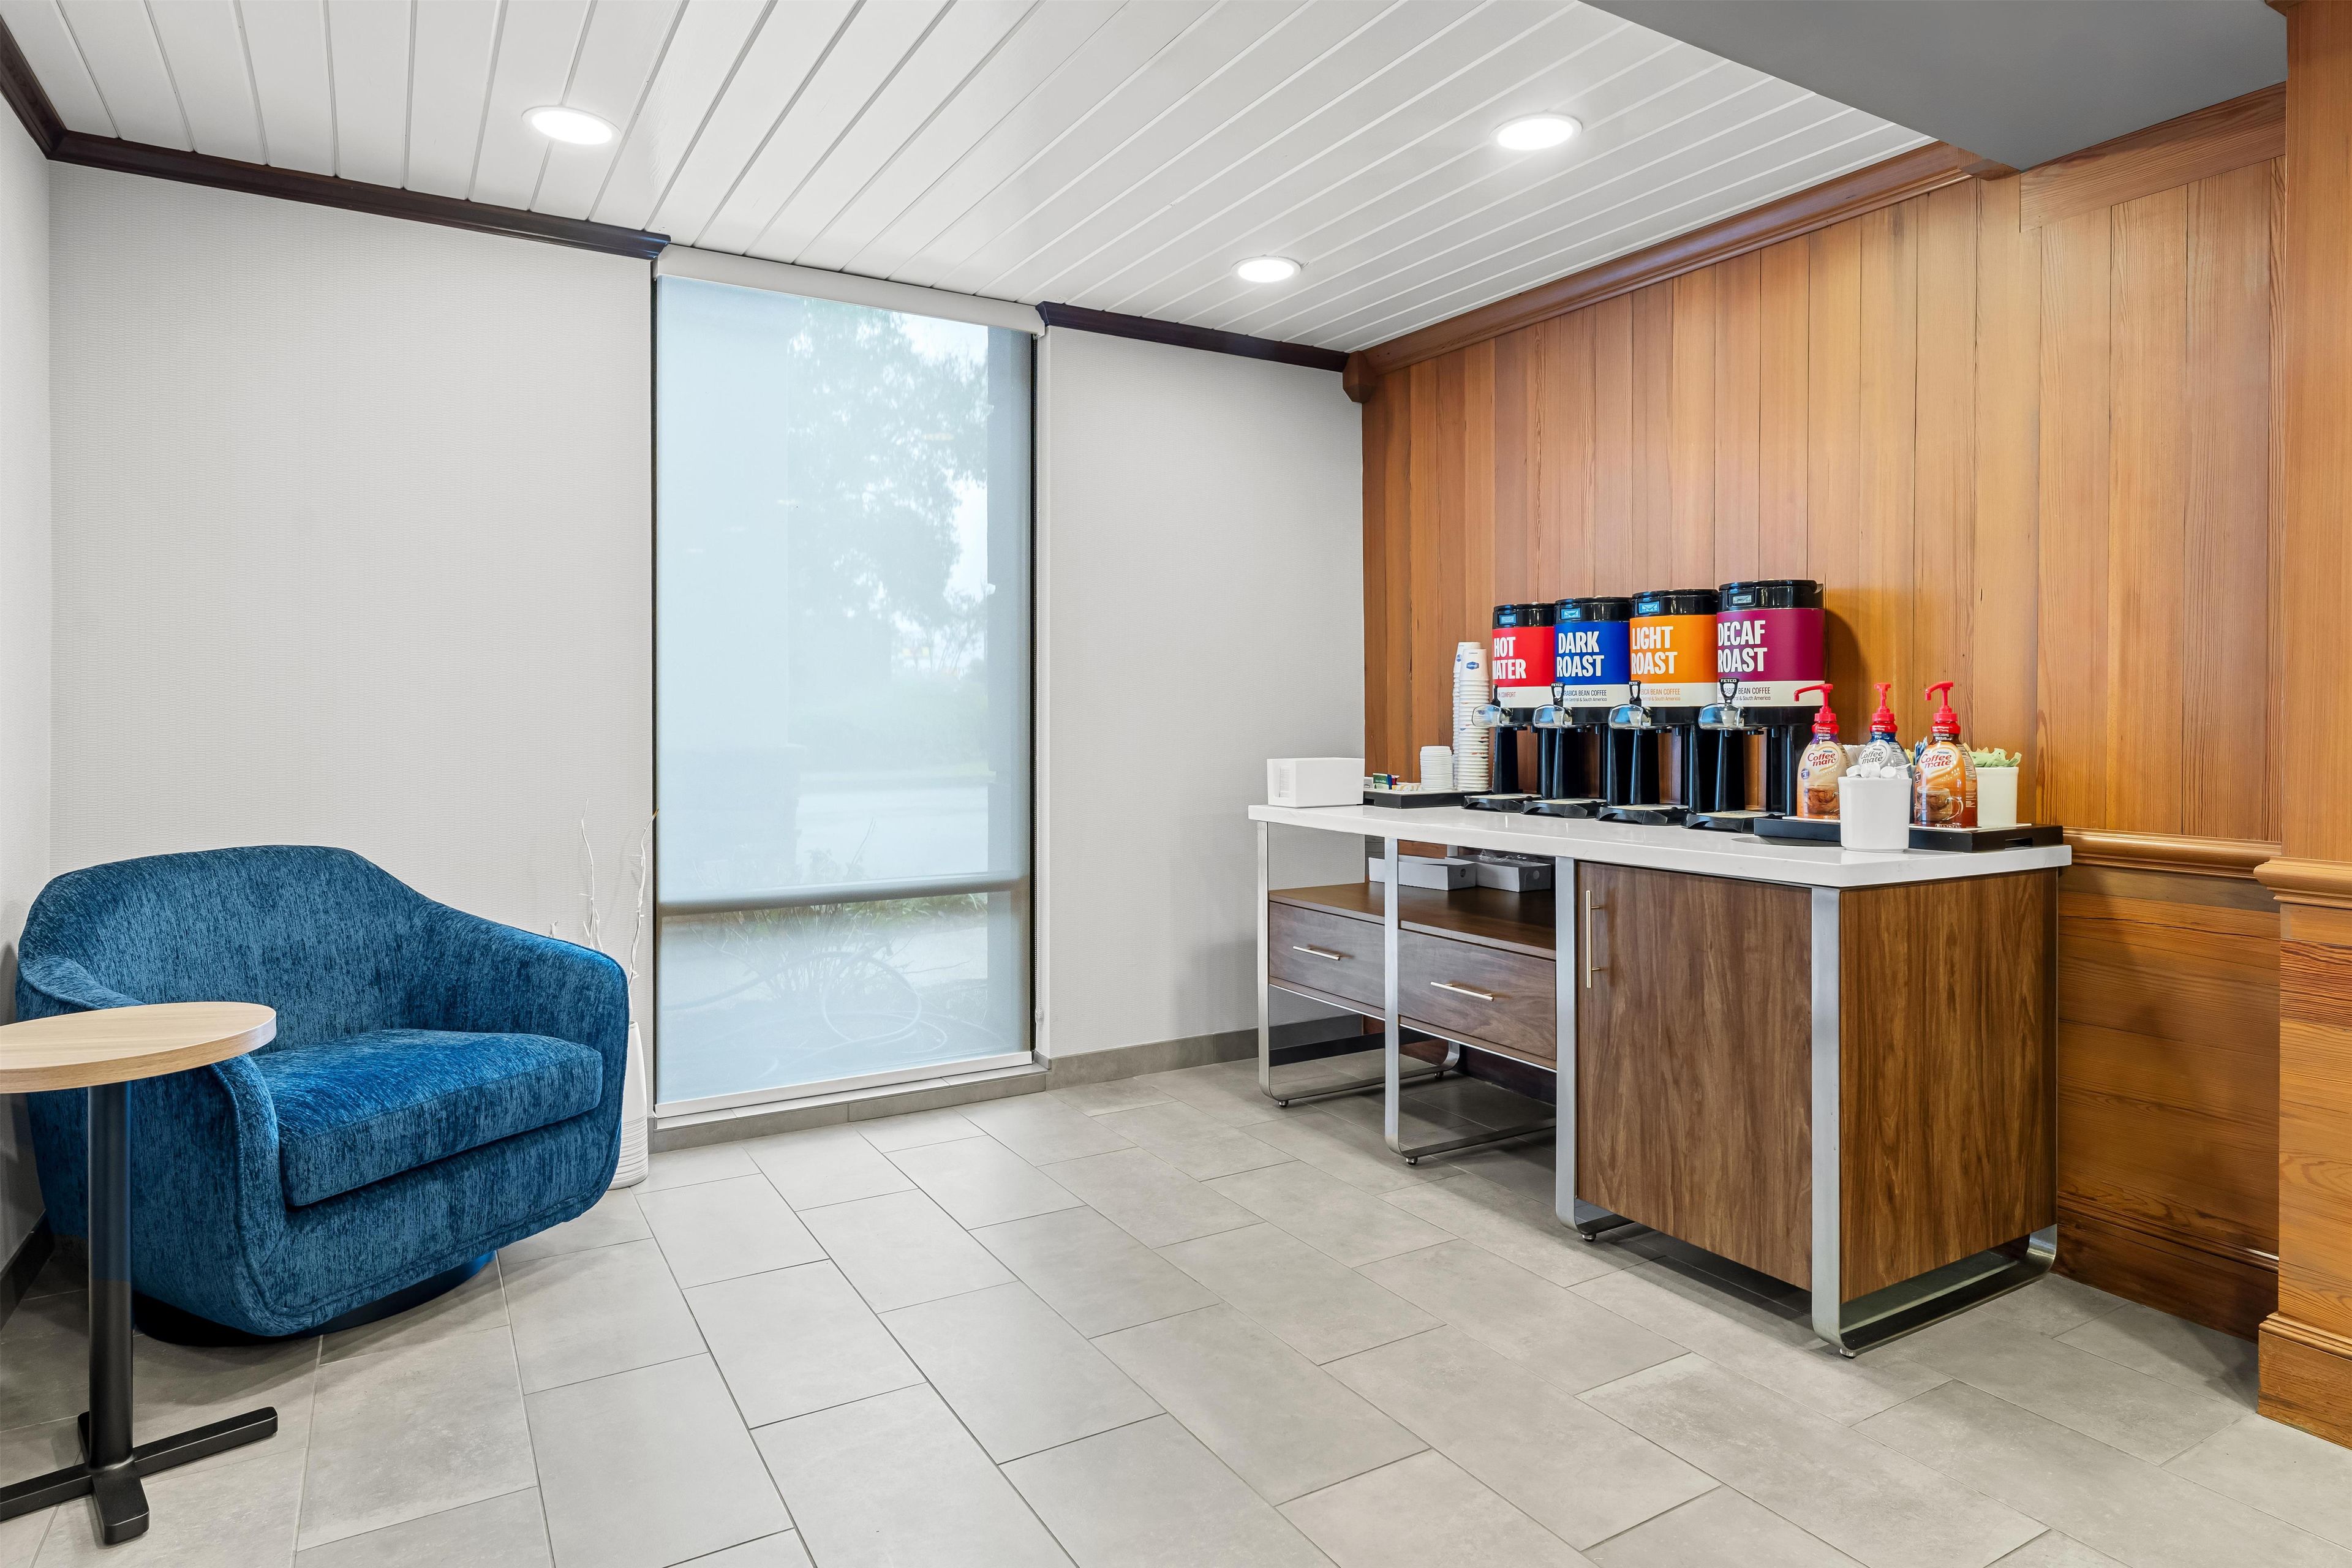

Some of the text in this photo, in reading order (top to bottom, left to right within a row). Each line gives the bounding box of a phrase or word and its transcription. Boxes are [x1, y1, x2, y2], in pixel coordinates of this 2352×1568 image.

[1558, 631, 1600, 654] DARK
[1632, 625, 1674, 650] LIGHT
[1717, 620, 1766, 646] DECAF
[1494, 636, 1516, 657] HOT
[1556, 655, 1605, 677] ROAST
[1631, 651, 1678, 675] ROAST
[1717, 647, 1768, 673] ROAST
[1807, 753, 1836, 762] Coffee
[1860, 750, 1883, 760] Coffee
[1921, 754, 1952, 764] Coffee
